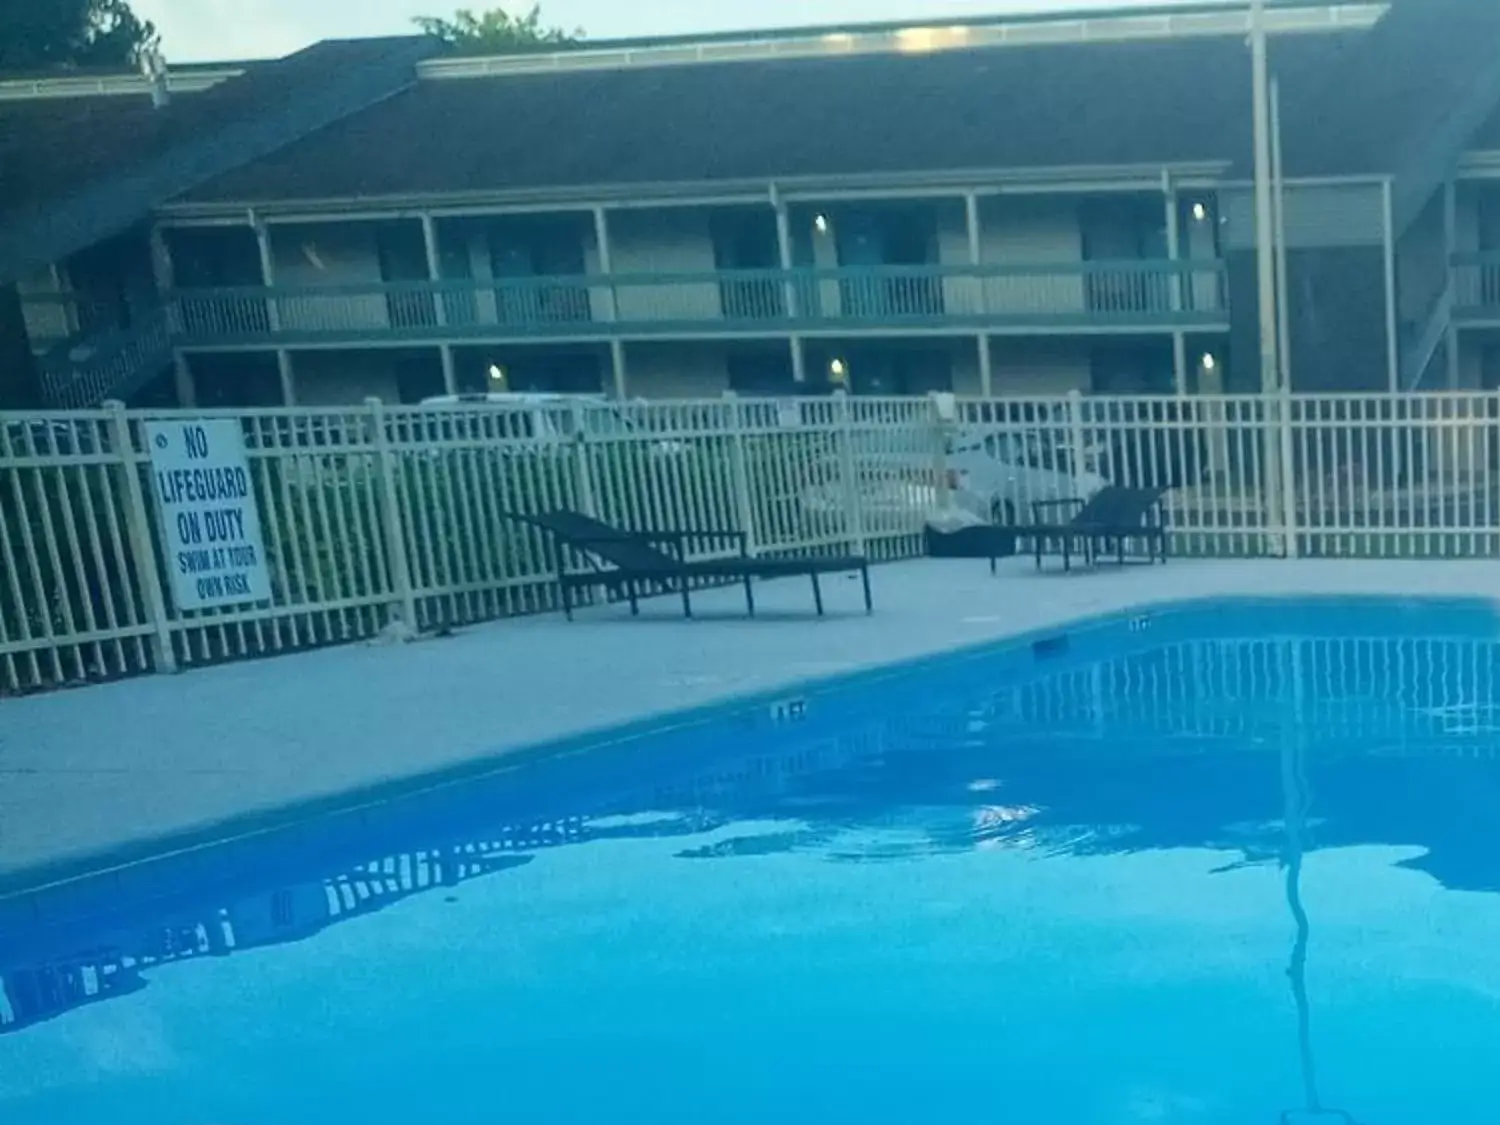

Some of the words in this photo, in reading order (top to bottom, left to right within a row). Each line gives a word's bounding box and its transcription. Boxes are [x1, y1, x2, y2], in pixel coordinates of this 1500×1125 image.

[183, 426, 208, 459] NO
[158, 466, 247, 503] LIFEGUARD
[177, 511, 201, 545] ON
[203, 507, 245, 542] DUTY
[178, 550, 211, 574] SWIM
[212, 547, 227, 569] AT
[227, 545, 257, 568] YOUR
[197, 575, 223, 599] OWN
[223, 573, 252, 596] RISK
